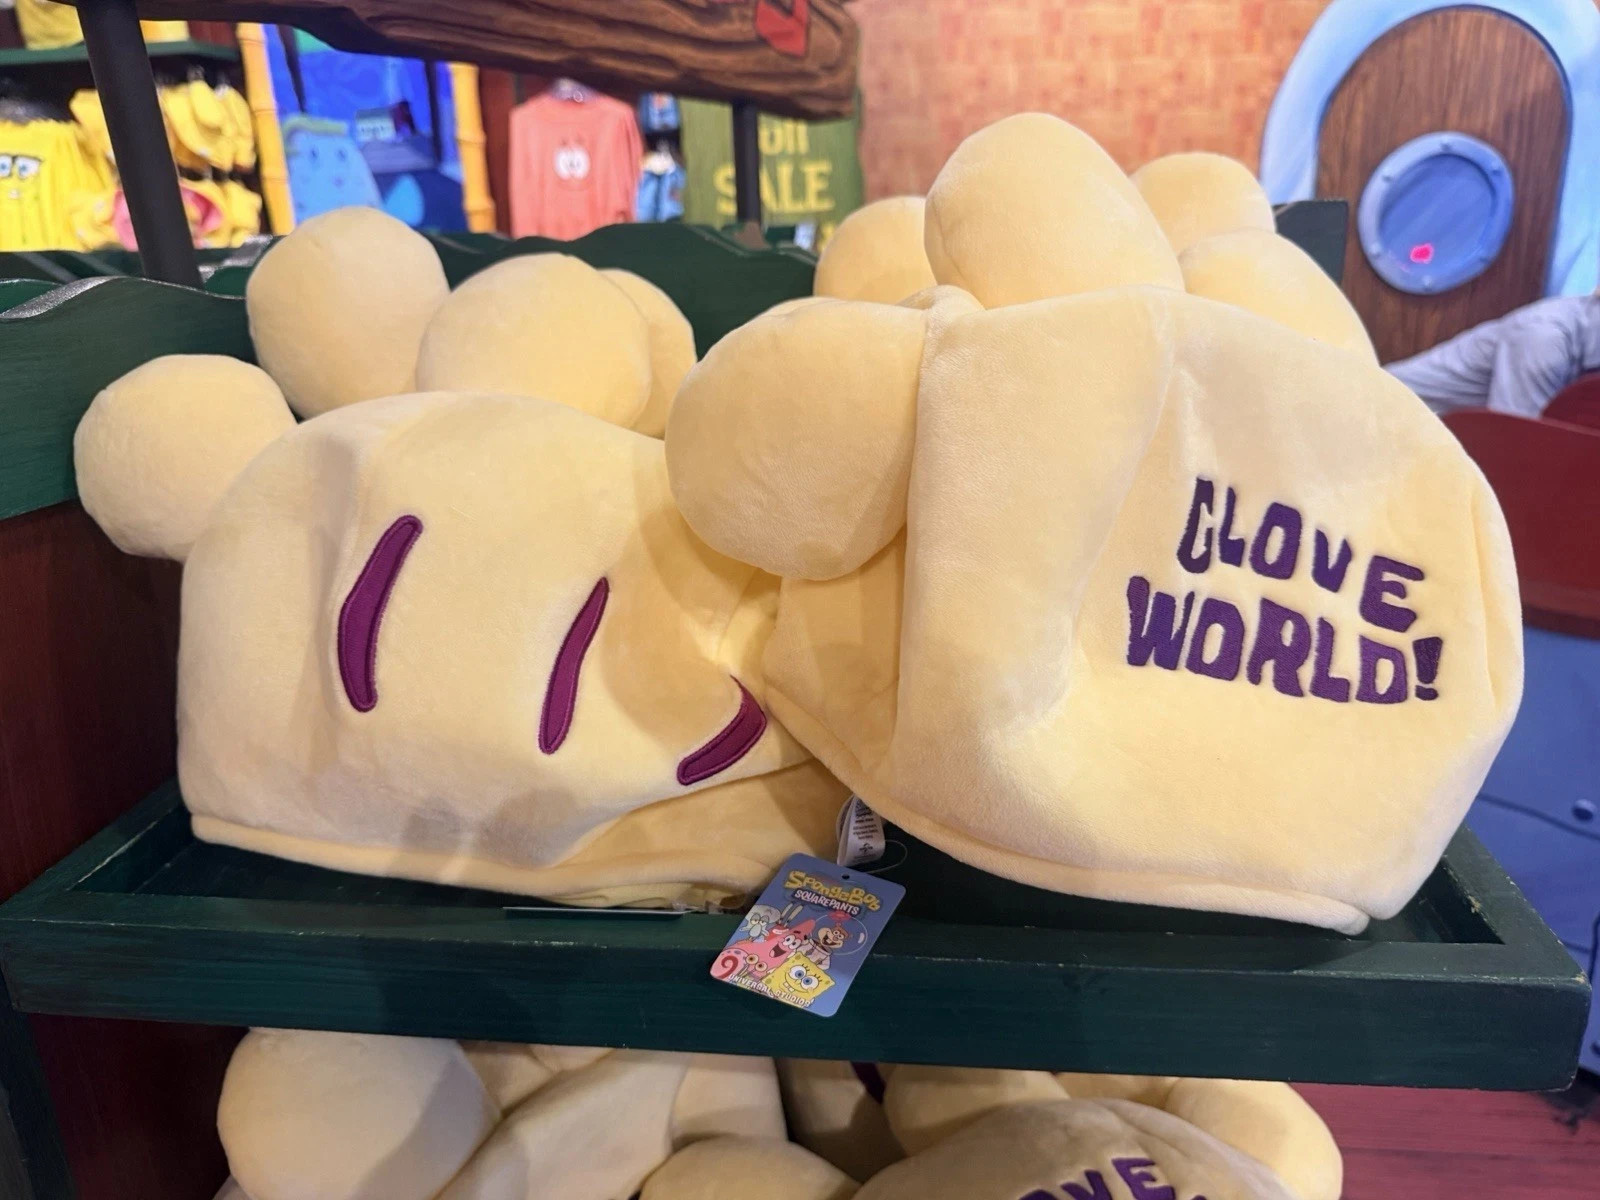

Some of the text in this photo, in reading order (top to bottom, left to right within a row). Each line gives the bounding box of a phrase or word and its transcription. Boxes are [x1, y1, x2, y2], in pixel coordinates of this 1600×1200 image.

[1177, 477, 1425, 633] GLOVE
[1126, 575, 1444, 705] WORLD!
[794, 889, 860, 916] SQUAREPANTS
[728, 974, 774, 998] UNIVERSAL
